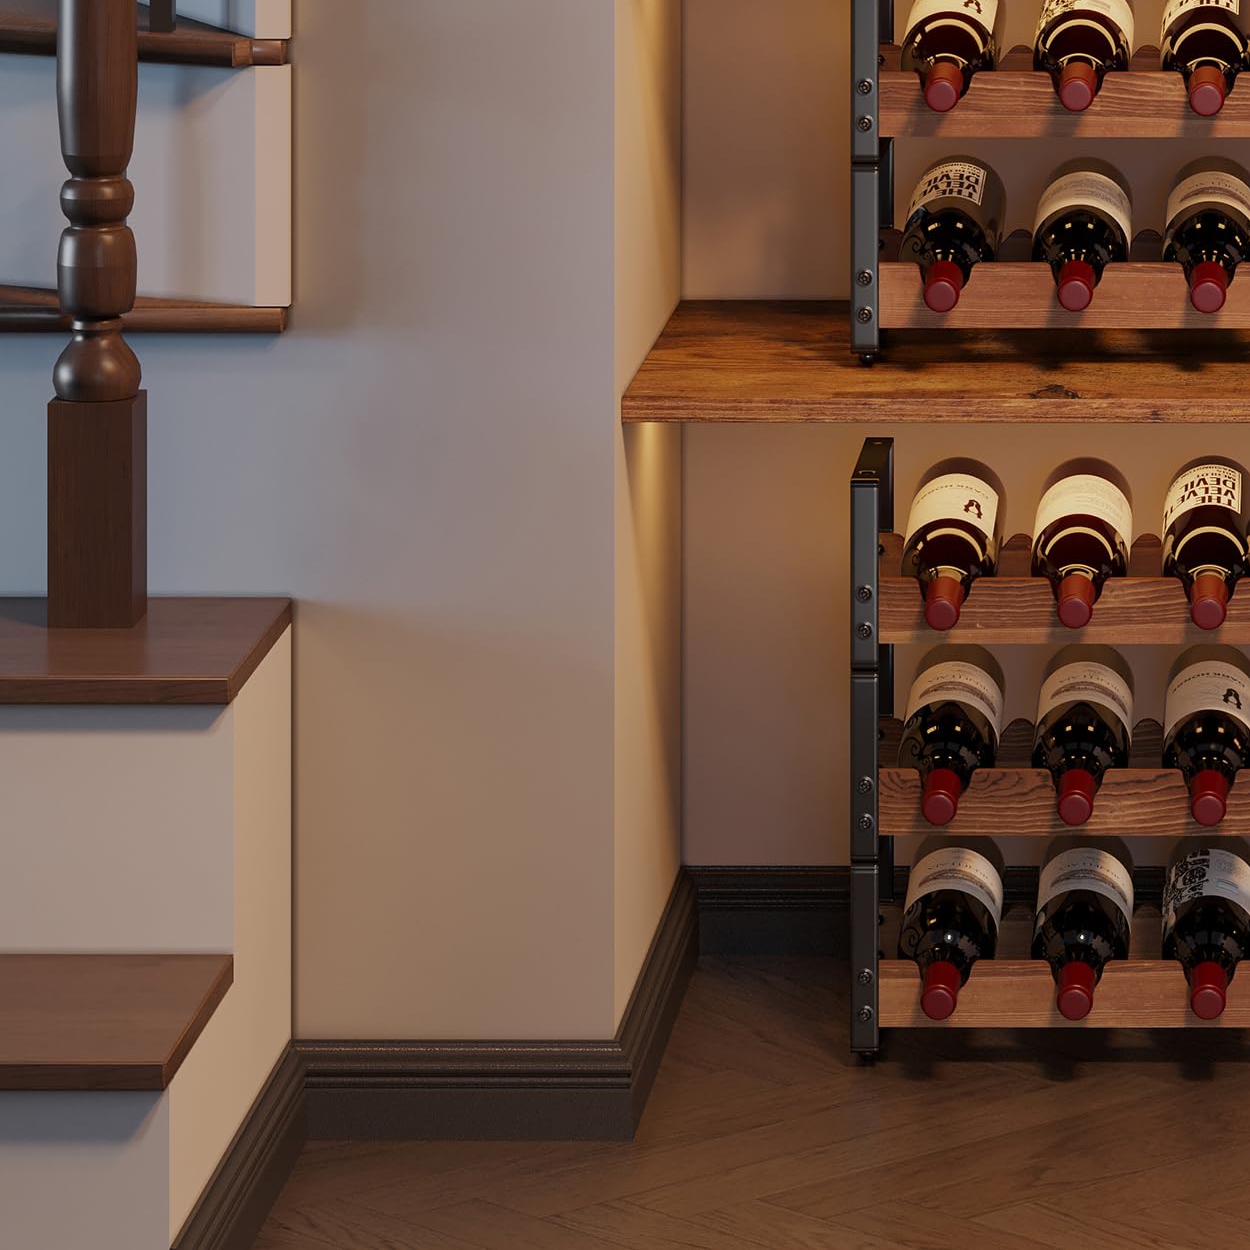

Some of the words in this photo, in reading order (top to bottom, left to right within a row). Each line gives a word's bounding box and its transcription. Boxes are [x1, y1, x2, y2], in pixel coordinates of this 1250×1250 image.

[923, 173, 979, 187] DEVIL
[936, 188, 976, 201] THE
[1178, 476, 1236, 492] DEVIL
[1192, 496, 1236, 508] THE
